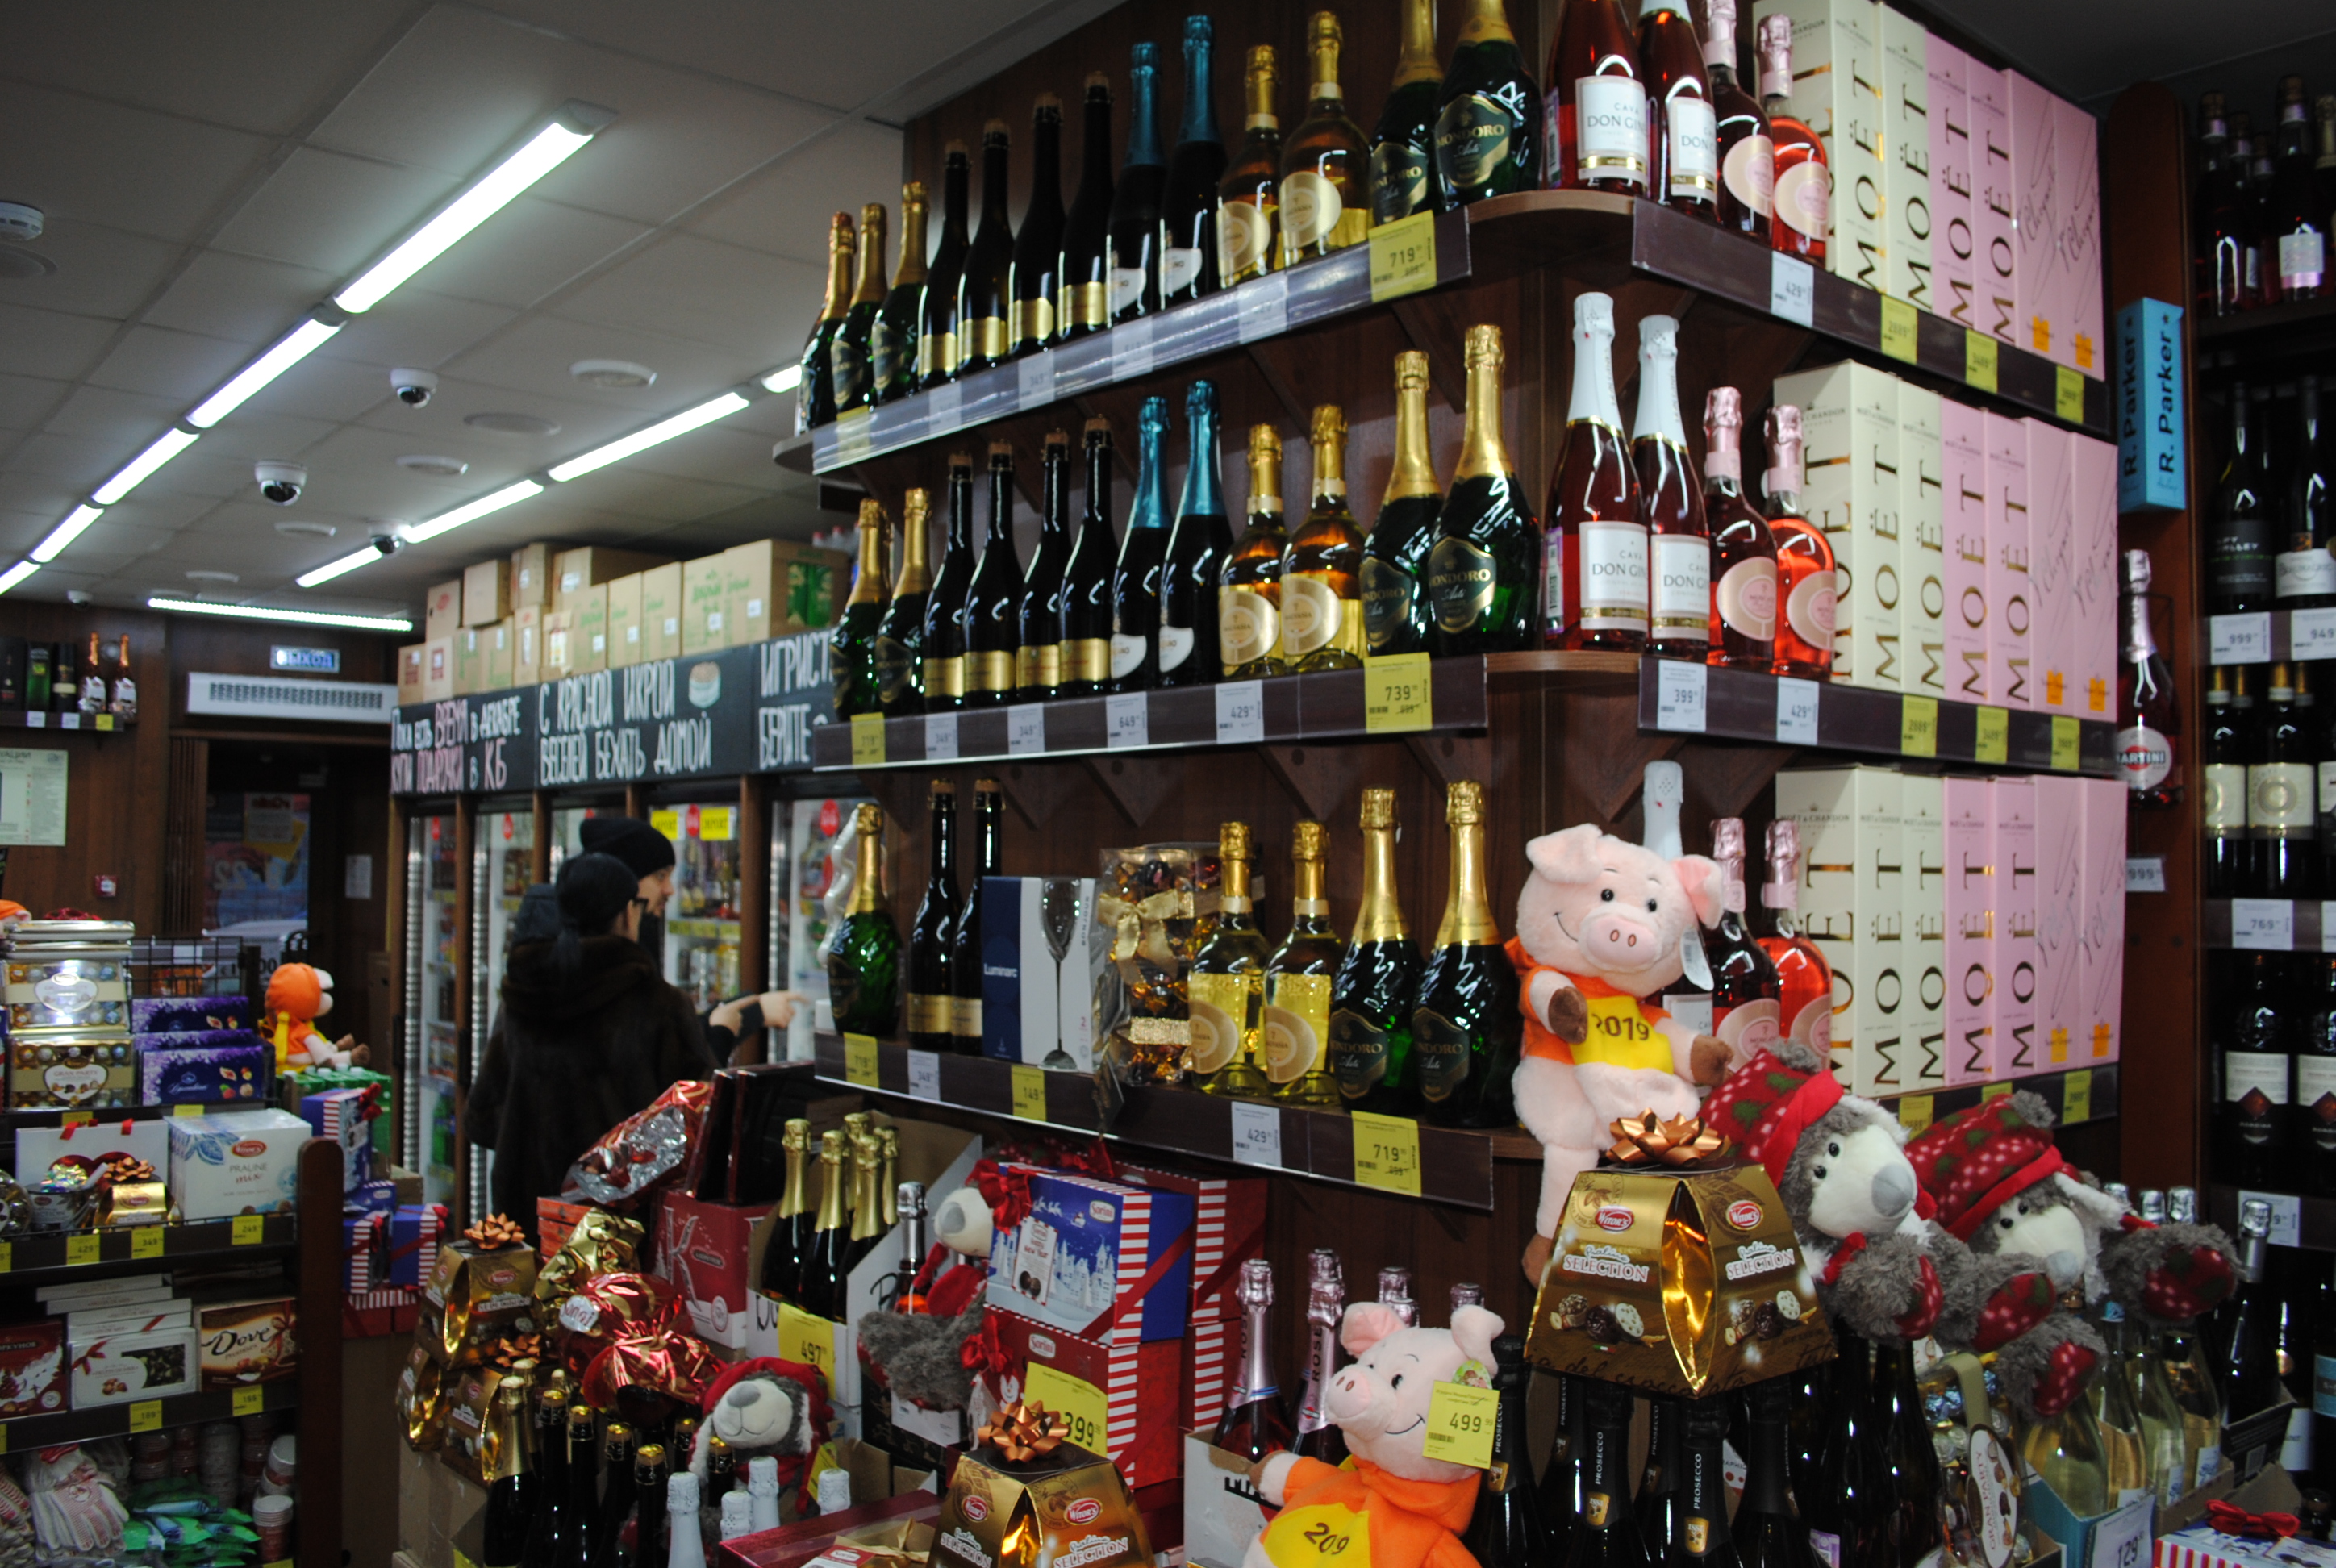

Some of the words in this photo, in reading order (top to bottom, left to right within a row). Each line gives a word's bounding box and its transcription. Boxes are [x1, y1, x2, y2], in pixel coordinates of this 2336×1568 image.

[1614, 102, 1639, 114] CAVA
[1587, 115, 1621, 127] DON
[1625, 117, 1646, 135] GIN
[1681, 135, 1708, 149] DON
[1899, 83, 1933, 310] MOËT
[1942, 108, 1974, 329] MOËT
[1984, 130, 2016, 343] MOËT
[1389, 247, 1416, 267] 719
[1785, 281, 1803, 297] 429
[2123, 336, 2137, 438] Parker
[2158, 332, 2173, 434] Parker
[2159, 446, 2174, 473] R.
[1620, 550, 1644, 560] CAVA
[1869, 444, 1900, 684] MOËT
[1592, 563, 1626, 576] DON
[1629, 565, 1647, 578] GIN
[1663, 575, 1695, 587] DON
[1916, 460, 1945, 690] MOËT
[1955, 474, 1988, 699] MOËT
[2000, 486, 2030, 703] MOËT
[277, 650, 333, 668] ЫХОД
[1385, 686, 1411, 701] 739
[1675, 689, 1693, 703] 399
[1231, 707, 1249, 719] 429
[1791, 705, 1807, 718] 429
[484, 737, 507, 791] КБ
[983, 962, 1018, 978] Luminarc
[1871, 848, 1902, 1086] MOËT
[1915, 849, 1945, 1082] MOËT
[1958, 850, 1992, 1074] MOËT
[2008, 852, 2035, 1070] MOËT
[1592, 1015, 1649, 1040] 2019
[1247, 1128, 1266, 1143] 429
[1373, 1144, 1400, 1161] 719
[229, 1162, 268, 1174] PRALINE
[1091, 1203, 1115, 1219] Sorini
[1563, 1255, 1650, 1282] SELECTION
[1725, 1249, 1796, 1281] SELECTION
[202, 1327, 271, 1356] Dove
[801, 1341, 823, 1365] 497
[1031, 1336, 1056, 1354] Sorini
[1450, 1412, 1481, 1433] 499
[1595, 1431, 1604, 1485] PROSECCO
[1053, 1537, 1128, 1568] SELECTION
